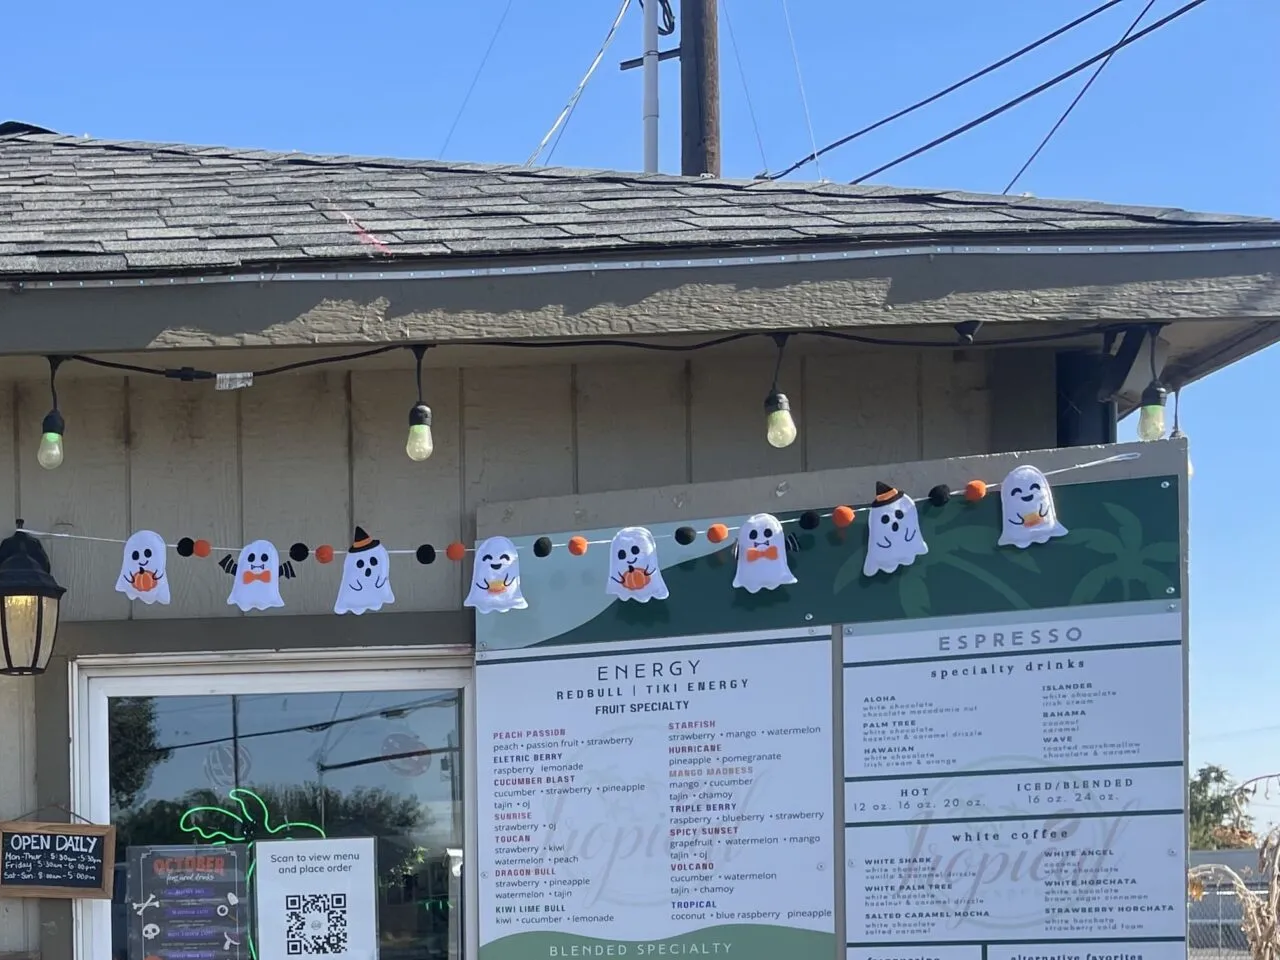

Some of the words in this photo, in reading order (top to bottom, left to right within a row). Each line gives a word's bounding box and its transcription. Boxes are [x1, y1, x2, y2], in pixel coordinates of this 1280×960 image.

[939, 627, 1082, 651] ESPRESSO
[598, 659, 702, 681] ENERGY
[931, 663, 1014, 679] specialty
[1025, 659, 1085, 671] drinks
[557, 686, 623, 701] REDBULL
[647, 683, 678, 695] TIKI
[688, 678, 749, 692] ENERGY
[1042, 683, 1092, 691] ISLANDER
[595, 703, 625, 715] FRUIT
[630, 700, 690, 713] SPECIALTY
[1043, 710, 1086, 718] BAHAMA
[668, 720, 715, 730] STARFISH
[526, 729, 566, 738] PASSION
[668, 733, 715, 741] strawberry
[726, 730, 757, 739] mango
[767, 726, 821, 736] watermelon
[493, 741, 518, 752] peach
[526, 740, 558, 750] passion
[561, 738, 578, 747] fruit
[587, 736, 633, 746] strawberry
[669, 744, 722, 754] HURRICANE
[864, 746, 915, 754] HAWAIIAN
[494, 754, 530, 763] ELETRIC
[534, 753, 563, 761] BERRY
[669, 768, 703, 777] MANGO
[707, 766, 753, 776] MADNESS
[494, 778, 542, 786] CUCUMBER
[546, 775, 575, 783] BLAST
[1017, 779, 1133, 791] ICED/BLENDED
[494, 788, 536, 798] cucumber
[546, 786, 592, 795] strawberry
[603, 783, 645, 793] pineapple
[901, 788, 929, 797] HOT
[1028, 795, 1040, 803] 16
[1075, 793, 1091, 802] 24
[670, 804, 701, 812] TRIPLE
[706, 803, 736, 811] BERRY
[854, 803, 866, 811] 12
[899, 801, 910, 809] 16
[944, 798, 959, 807] 20
[494, 812, 532, 820] SUNRISE
[670, 815, 712, 825] raspberry
[722, 813, 765, 822] blueberry
[776, 811, 824, 821] strawberry
[702, 827, 738, 835] SUNSET
[952, 831, 1000, 842] white
[1011, 829, 1068, 839] coffee
[11, 835, 50, 850] OPEN
[56, 835, 97, 853] DAILY
[495, 835, 530, 843] TOUCAN
[271, 854, 294, 863] Scan
[297, 854, 306, 862] to
[333, 852, 360, 860] menu
[154, 856, 224, 874] OCTOBER
[279, 865, 297, 874] and
[300, 864, 324, 875] place
[327, 864, 352, 872] order
[671, 863, 714, 871] VOLCANO
[534, 868, 556, 876] BULL
[545, 904, 566, 912] BULL
[521, 915, 562, 923] cucumber
[572, 914, 614, 922] lemonade
[671, 912, 705, 920] coconut
[716, 911, 735, 919] blue
[737, 911, 780, 919] raspberry
[787, 910, 832, 918] pineapple
[550, 945, 627, 956] BLENDED
[637, 943, 732, 955] SPECIALTY
